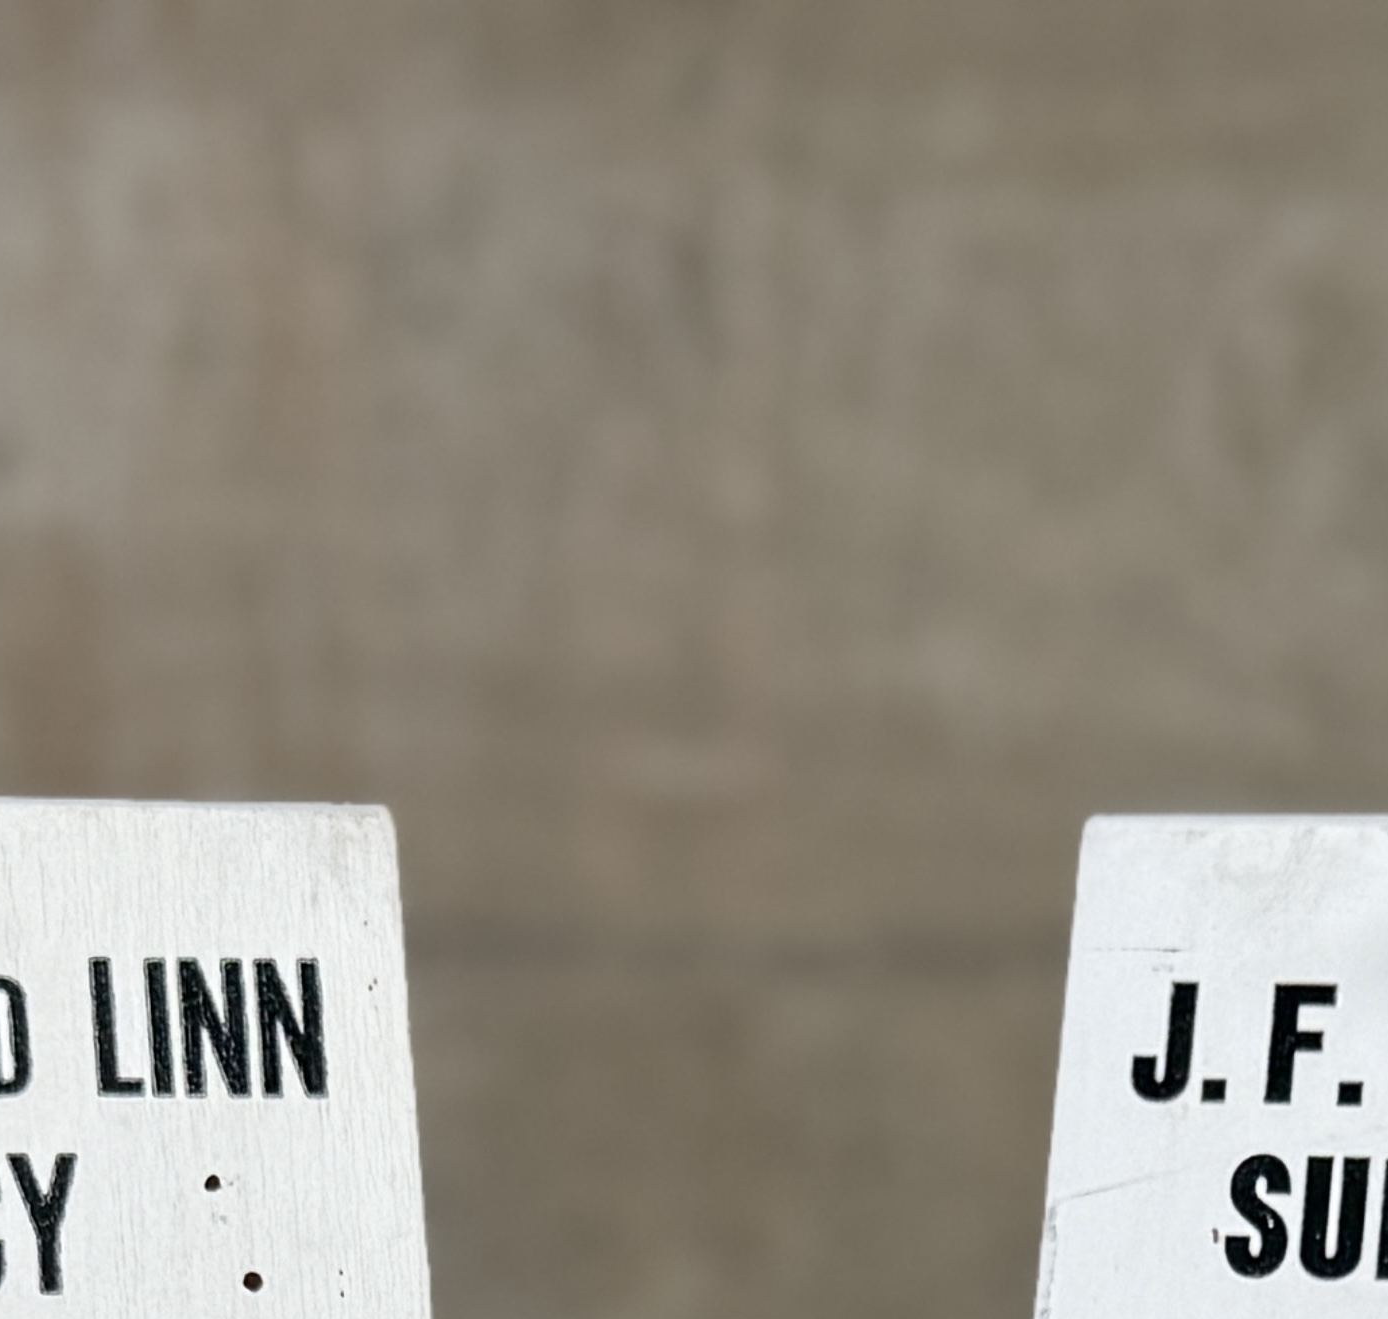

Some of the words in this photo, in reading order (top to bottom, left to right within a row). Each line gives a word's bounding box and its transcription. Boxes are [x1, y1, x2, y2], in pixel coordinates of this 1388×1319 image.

[87, 955, 329, 1097] LINN
[1130, 980, 1228, 1104] J.
[1262, 982, 1365, 1107] F.
